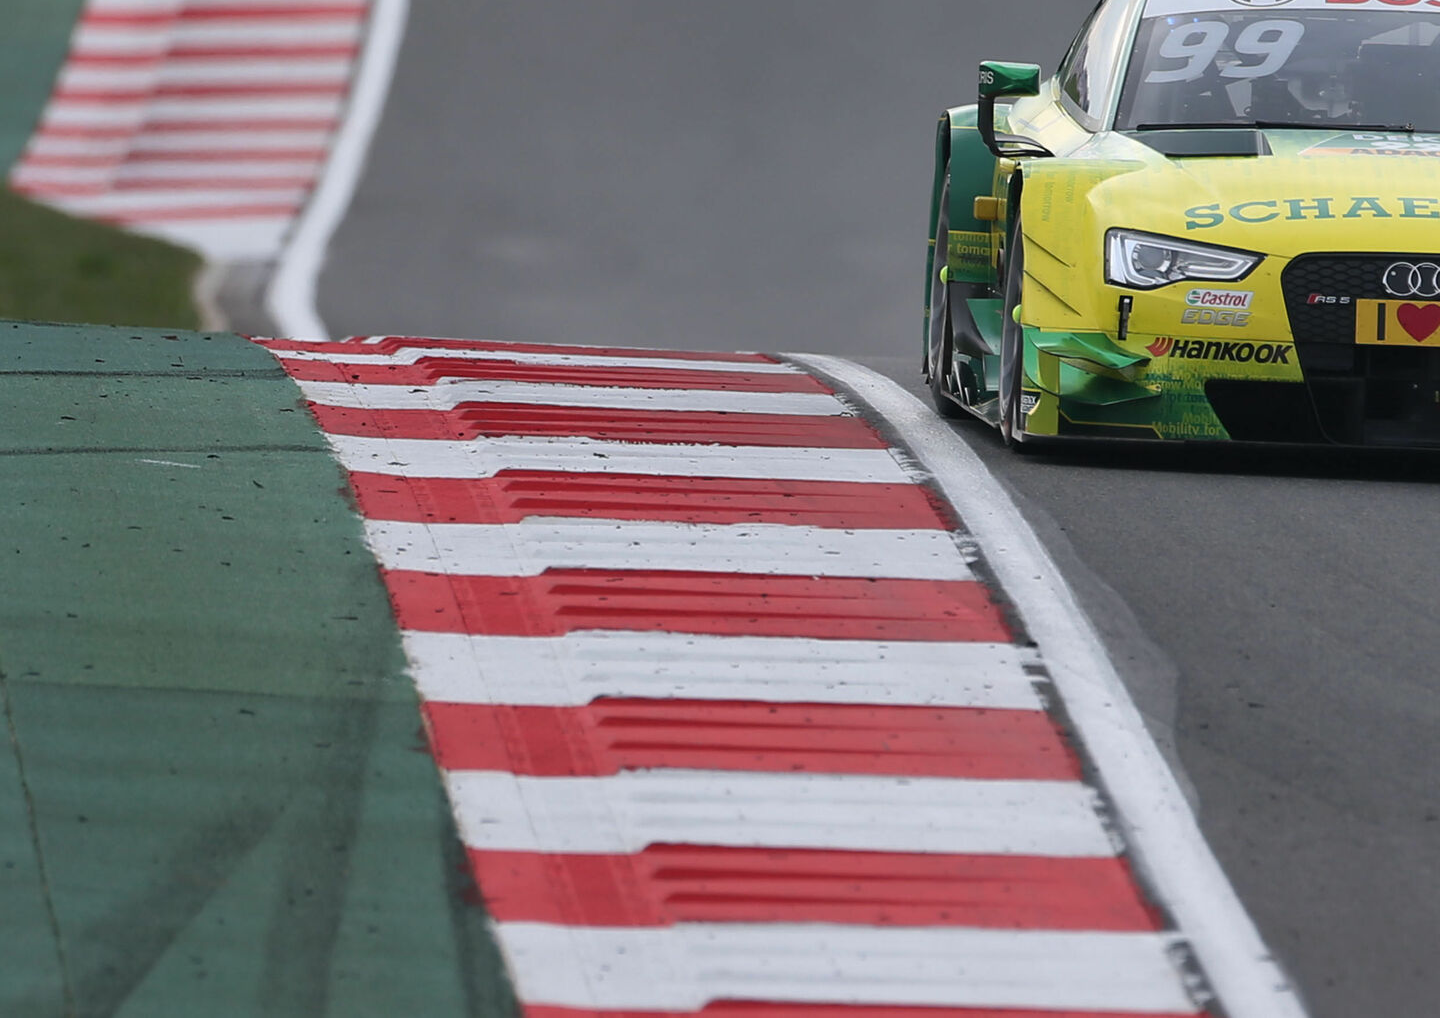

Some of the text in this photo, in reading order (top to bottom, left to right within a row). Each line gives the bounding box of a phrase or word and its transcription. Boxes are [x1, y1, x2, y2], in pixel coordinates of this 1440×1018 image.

[1144, 19, 1305, 83] 99
[1200, 291, 1248, 307] Castrol
[1181, 309, 1252, 327] EDGE
